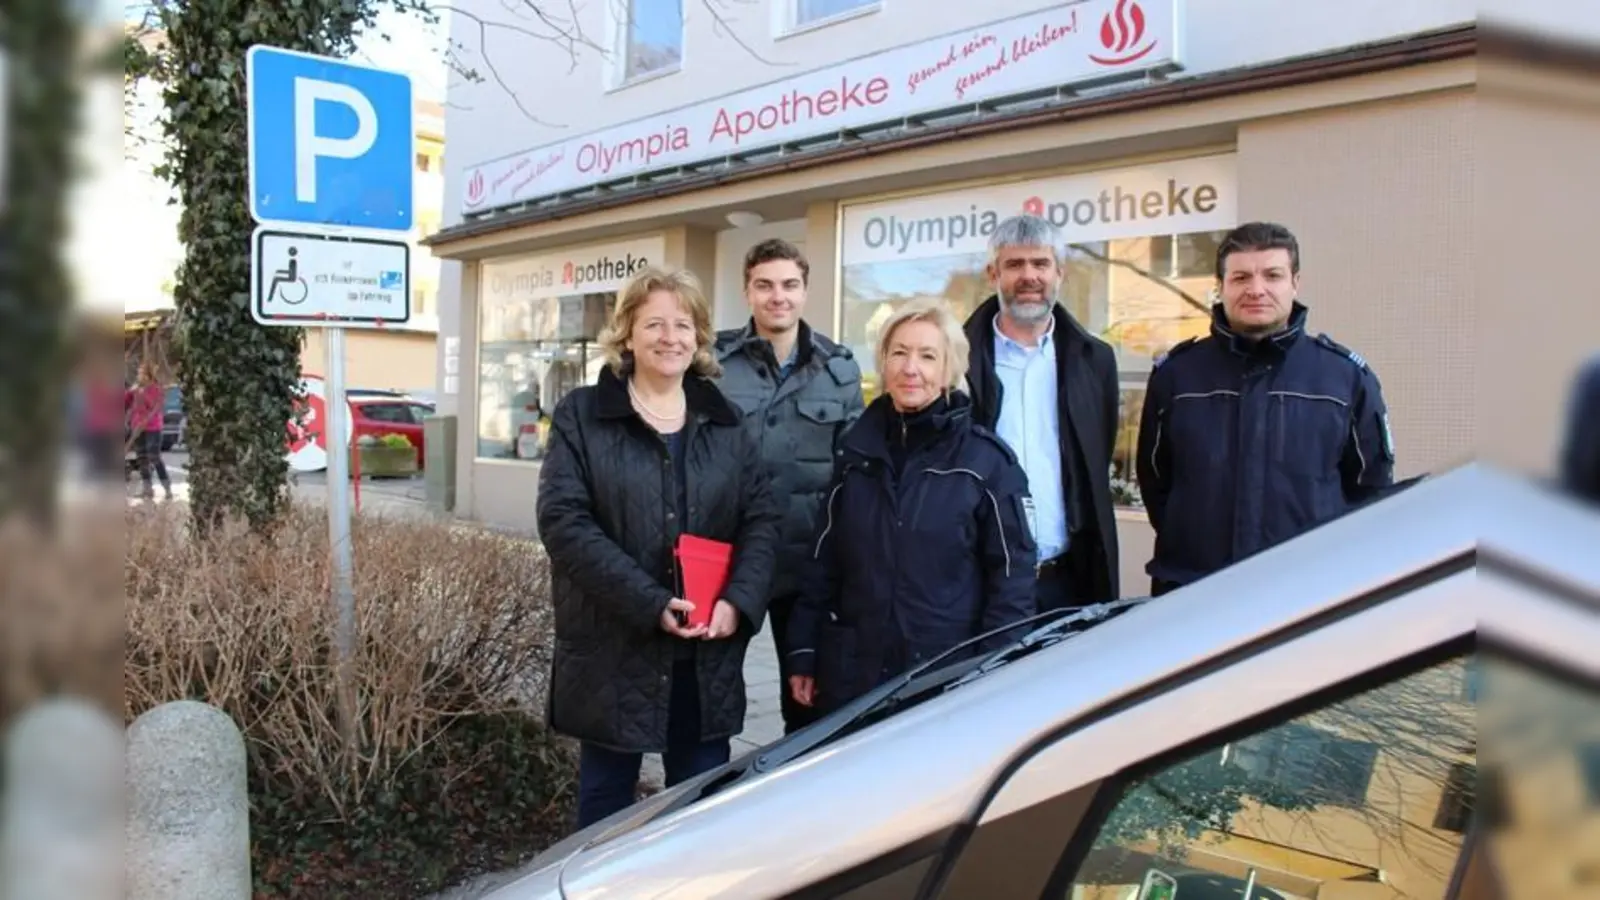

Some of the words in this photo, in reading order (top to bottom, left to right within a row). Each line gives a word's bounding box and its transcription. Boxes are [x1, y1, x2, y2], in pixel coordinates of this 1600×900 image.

[907, 44, 958, 95] gesund
[954, 46, 1008, 100] gesund
[1011, 9, 1077, 62] bleiben!
[294, 76, 378, 204] P
[575, 124, 690, 174] Olympia
[708, 75, 890, 145] Apotheke
[863, 204, 998, 254] Olympia
